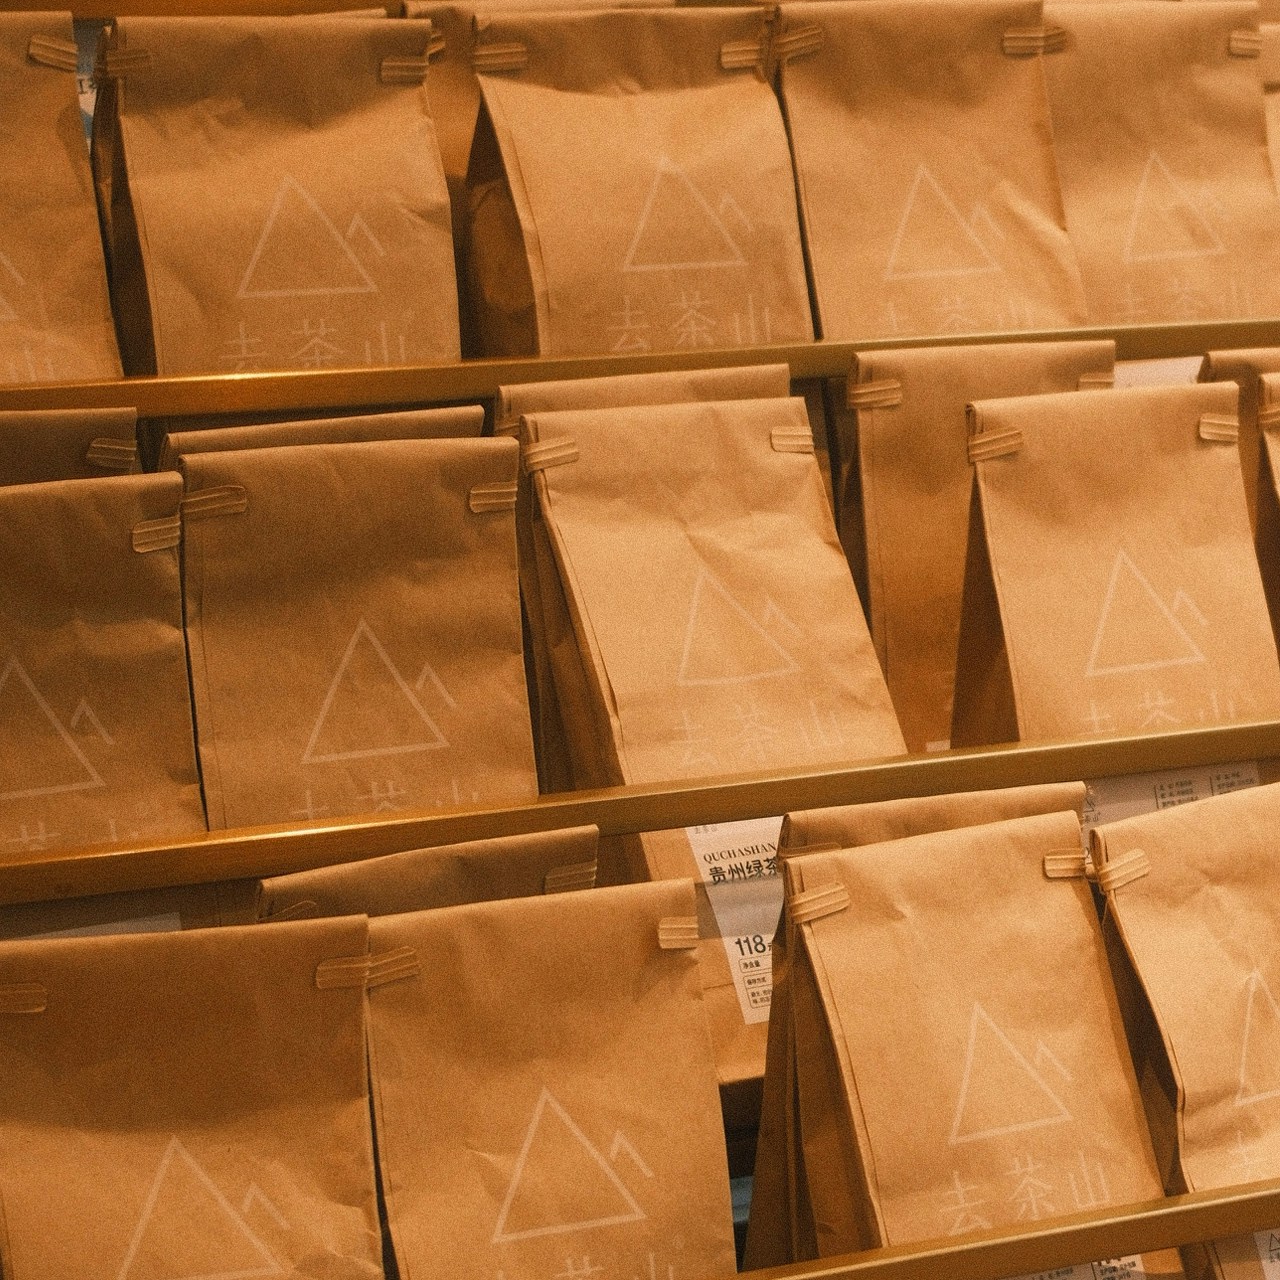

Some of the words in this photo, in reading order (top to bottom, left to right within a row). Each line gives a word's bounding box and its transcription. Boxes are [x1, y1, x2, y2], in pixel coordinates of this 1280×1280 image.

[608, 290, 775, 352] 去茶山
[703, 842, 777, 864] QUCHASHAN
[709, 857, 778, 885] 贵州绿茶
[940, 1150, 1117, 1232] 去茶山
